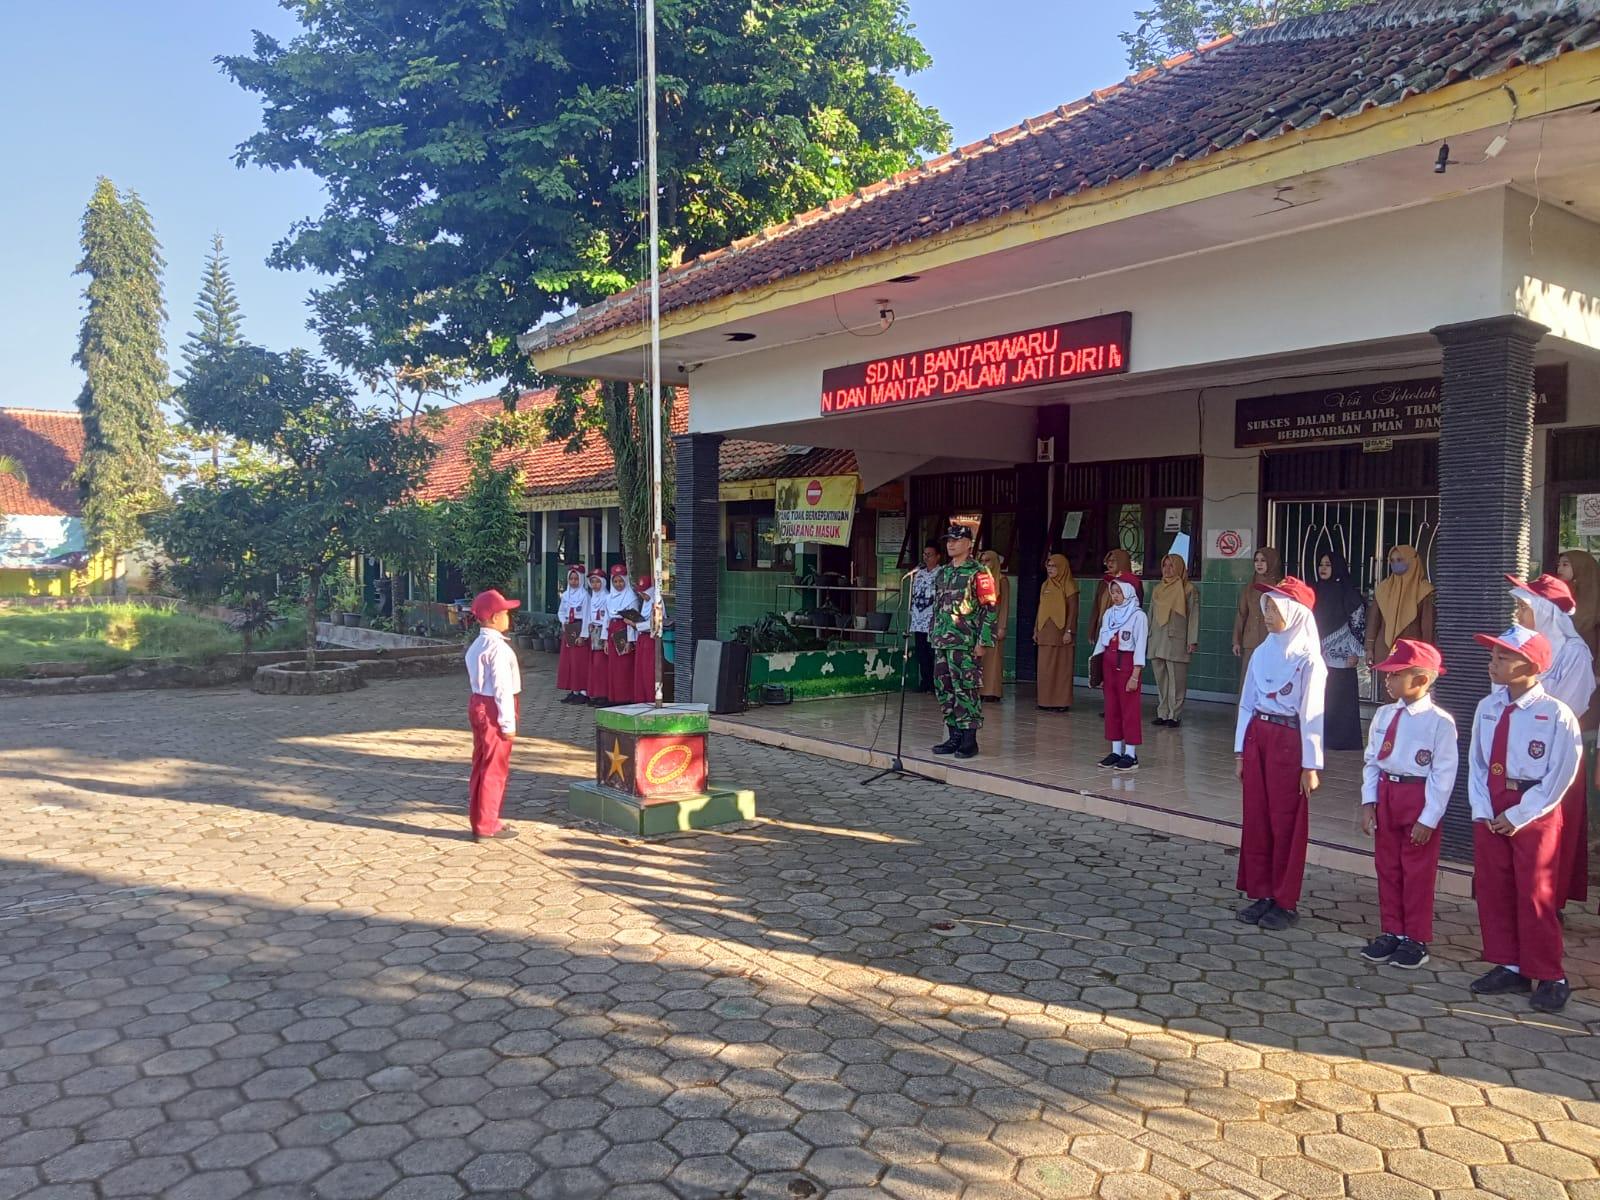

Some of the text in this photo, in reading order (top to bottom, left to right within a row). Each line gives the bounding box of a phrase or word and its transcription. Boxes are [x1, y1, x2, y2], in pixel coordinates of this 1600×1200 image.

[910, 356, 917, 377] 1
[924, 329, 1059, 374] BANTARWARU
[836, 386, 867, 410] DAN
[870, 374, 939, 405] MANTAP
[943, 362, 1006, 394] DALAM
[1011, 354, 1055, 383] JATI
[1060, 345, 1104, 376] DIRI
[1323, 385, 1438, 408] Visi Sekolah
[1247, 417, 1290, 431] SUKSES
[1296, 413, 1336, 426] DALAM
[1277, 416, 1441, 441] BERDASARKAN IMAN DAN
[781, 524, 841, 539] DILARANG MASUK
